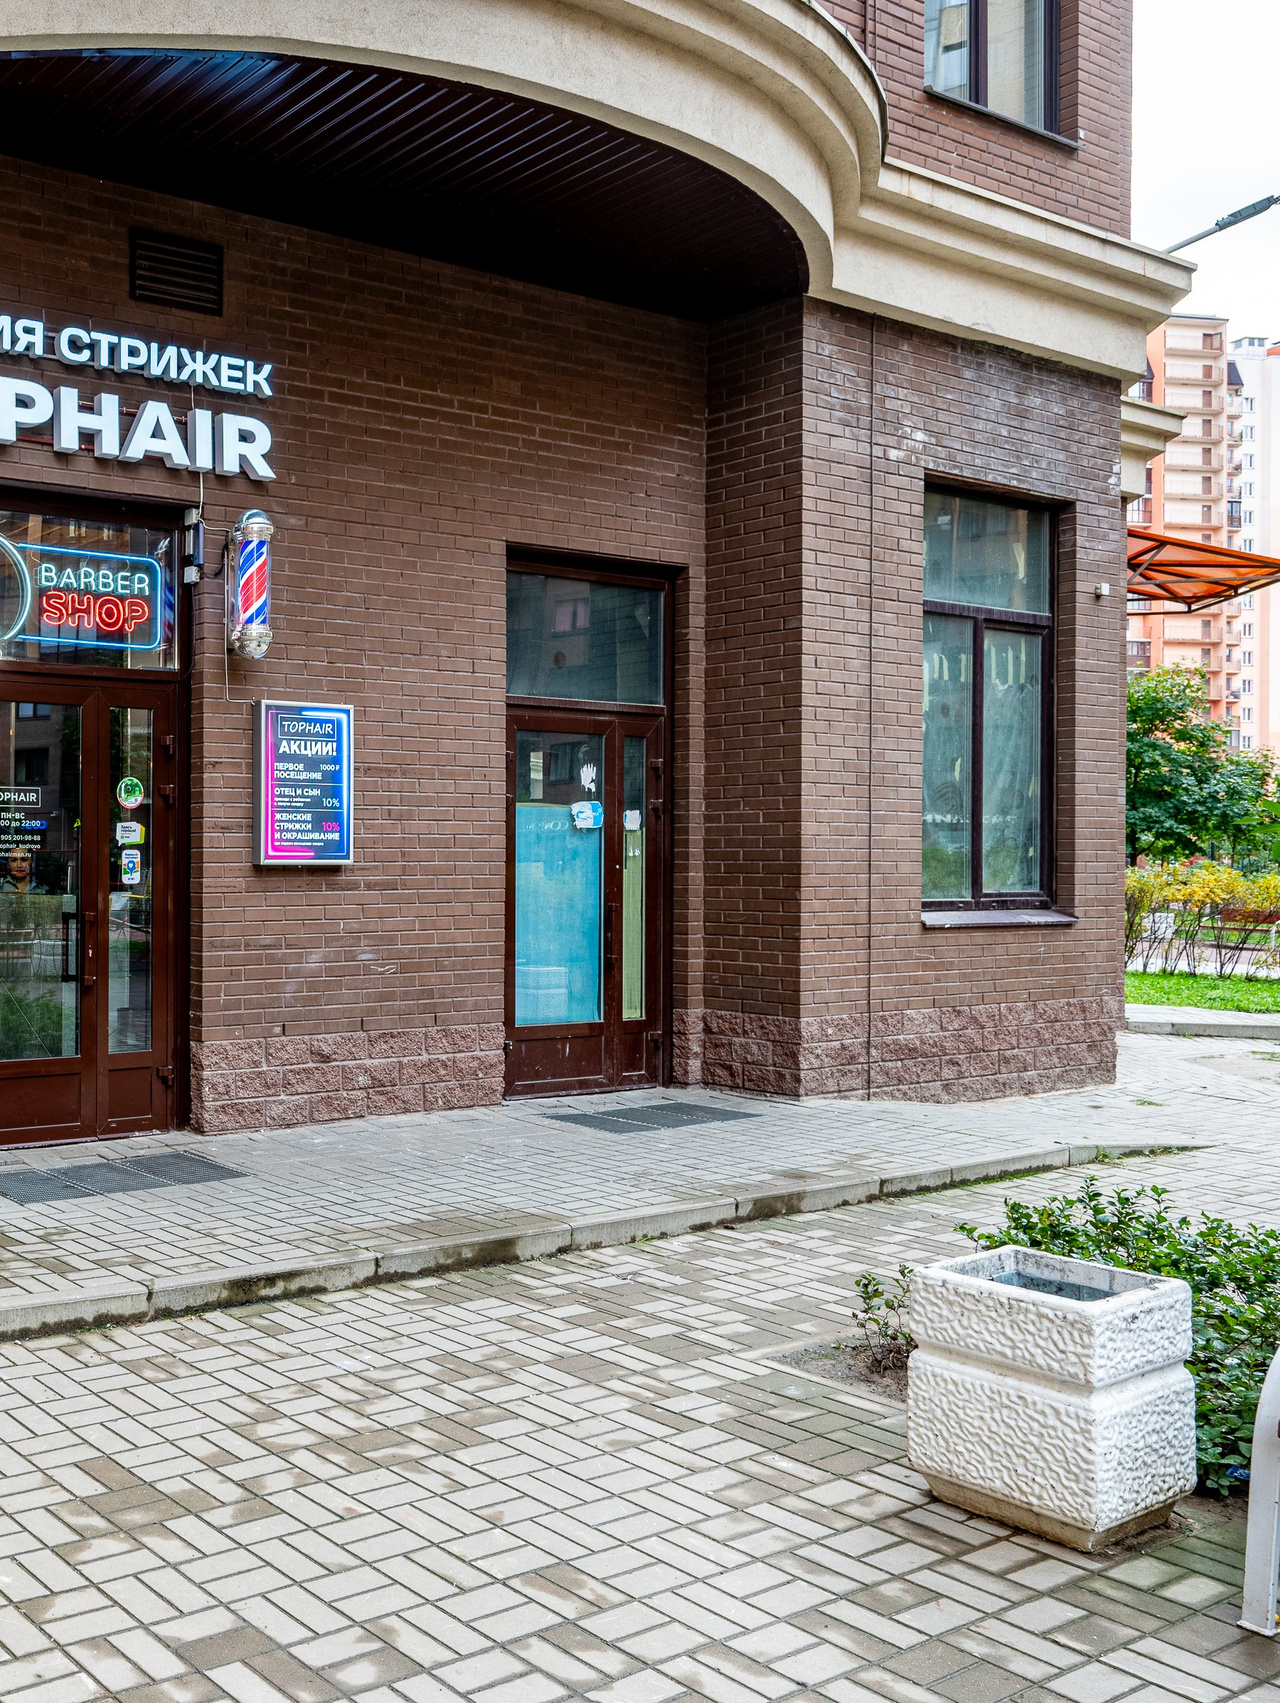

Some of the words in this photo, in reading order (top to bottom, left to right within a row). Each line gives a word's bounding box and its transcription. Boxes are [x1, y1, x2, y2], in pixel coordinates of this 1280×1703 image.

[54, 326, 273, 398] СТРИЖЕК
[41, 563, 149, 595] BARBER
[43, 590, 149, 632] SHOP
[282, 721, 333, 735] TOPHAIR
[278, 740, 337, 757] АКЦИИ!
[274, 762, 304, 771] ПЕРВОЕ
[274, 771, 322, 780] ПОСЕЩЕНИЕ
[274, 787, 295, 796] ОТЕЦ
[296, 788, 302, 796] И
[303, 788, 321, 796] СЫН
[322, 797, 340, 807] 10%
[274, 813, 312, 821] ЖЕНСКИЕ
[274, 822, 312, 830] СТРИЖКИ
[322, 821, 340, 831] 10%
[282, 832, 340, 840] ОКРАШИВАНИЕ
